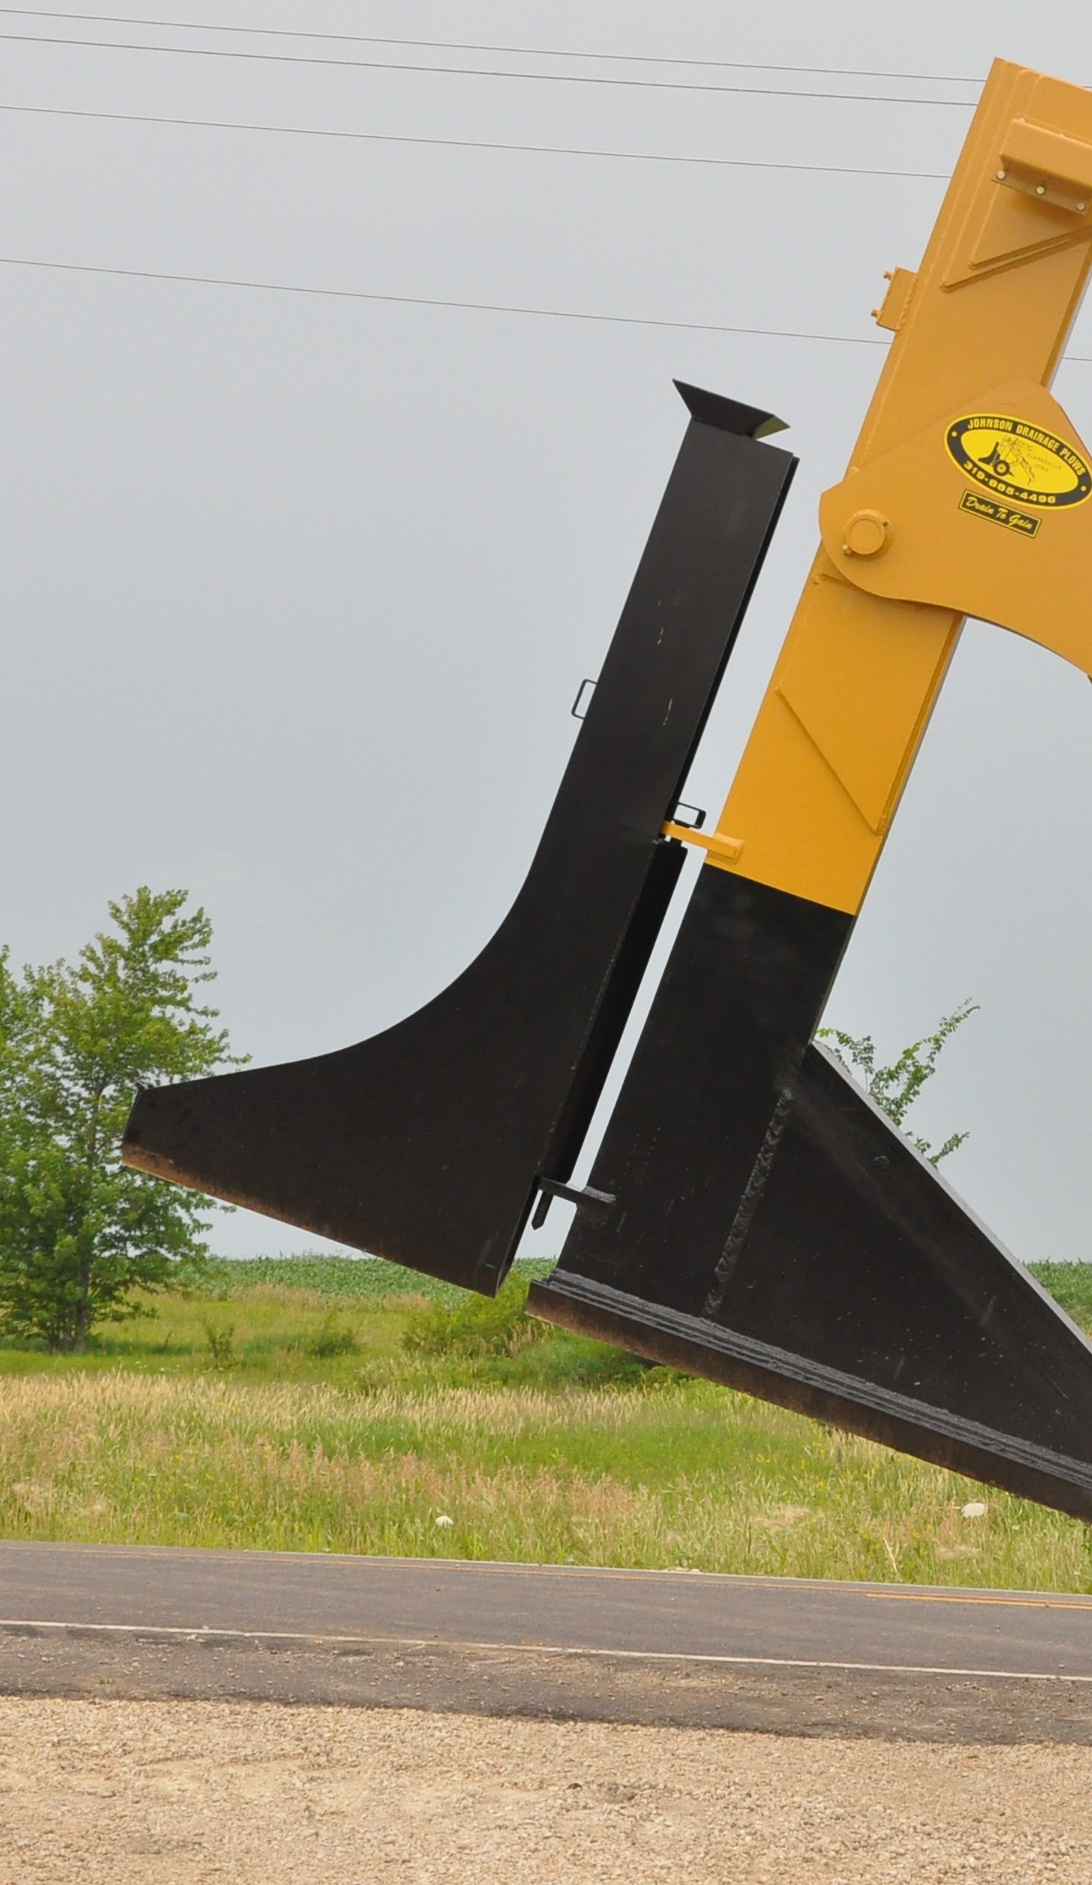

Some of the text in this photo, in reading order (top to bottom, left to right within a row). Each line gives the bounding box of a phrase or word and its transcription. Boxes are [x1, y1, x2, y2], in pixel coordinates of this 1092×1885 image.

[967, 418, 1086, 476] JOHNSON DRAINAGE PLOWS
[965, 496, 1033, 530] Drain To Gain
